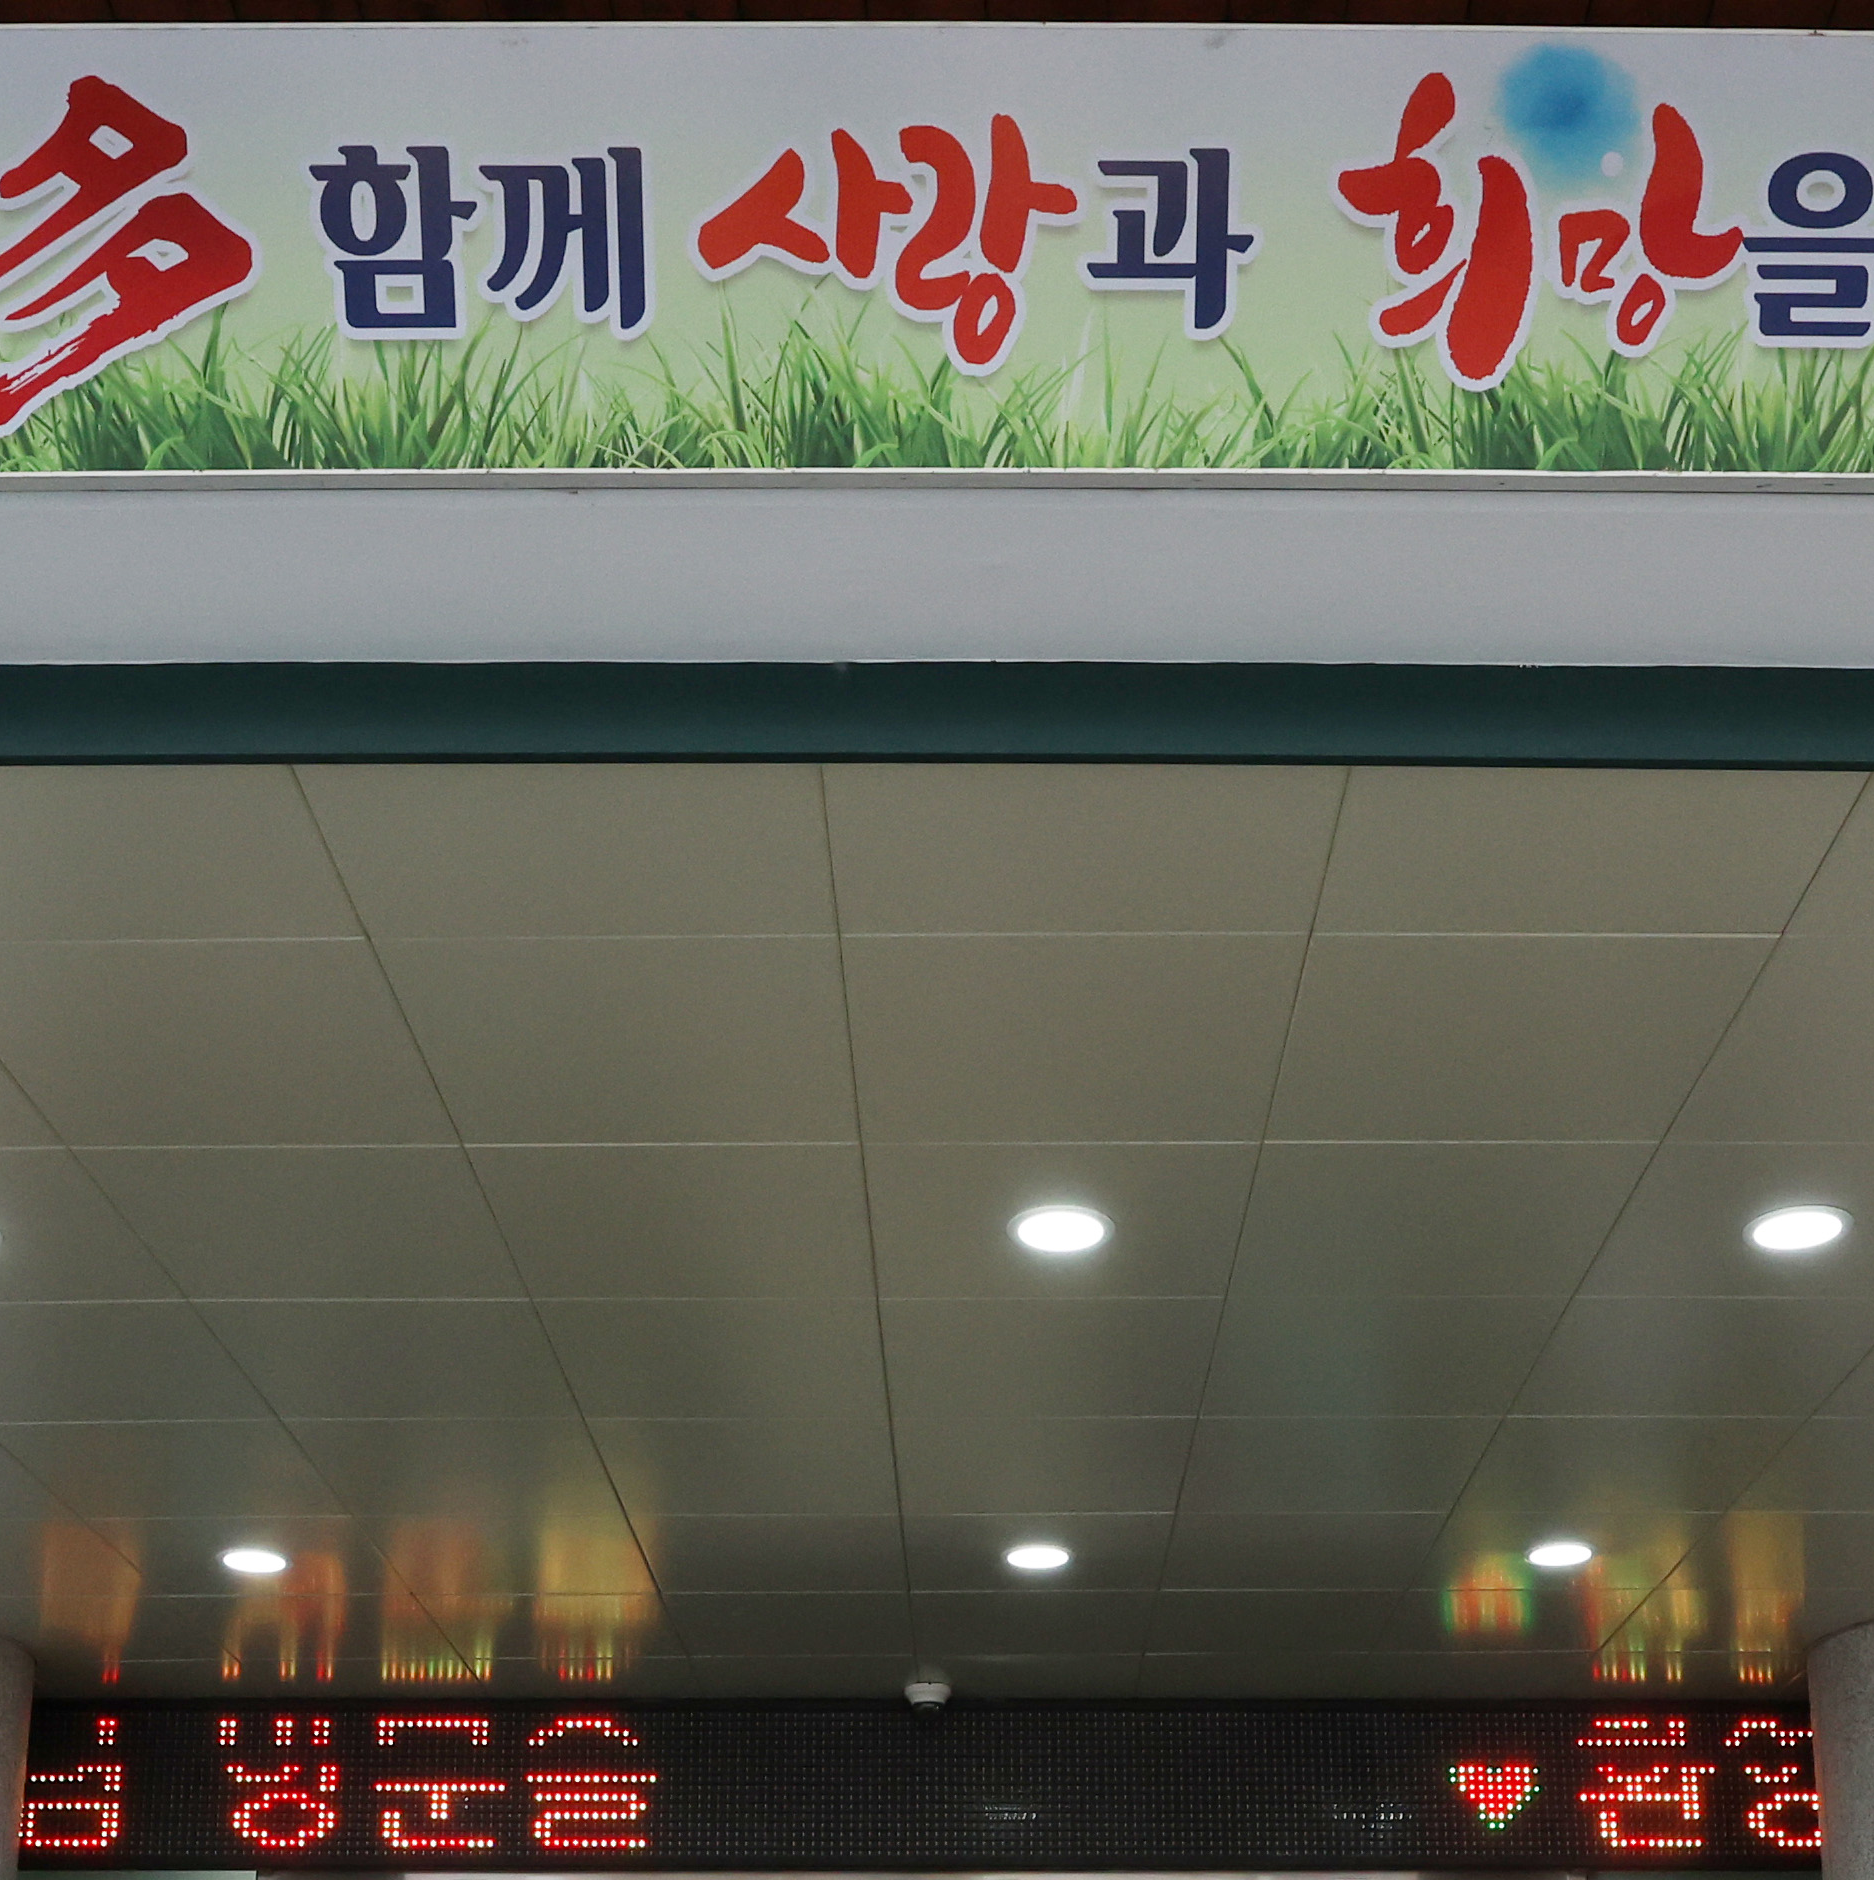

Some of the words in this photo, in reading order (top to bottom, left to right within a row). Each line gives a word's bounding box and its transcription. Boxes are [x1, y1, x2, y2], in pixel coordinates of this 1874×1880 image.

[310, 145, 646, 330] 함께
[699, 114, 1254, 363] 사랑과
[220, 1717, 658, 1848] 방문을
